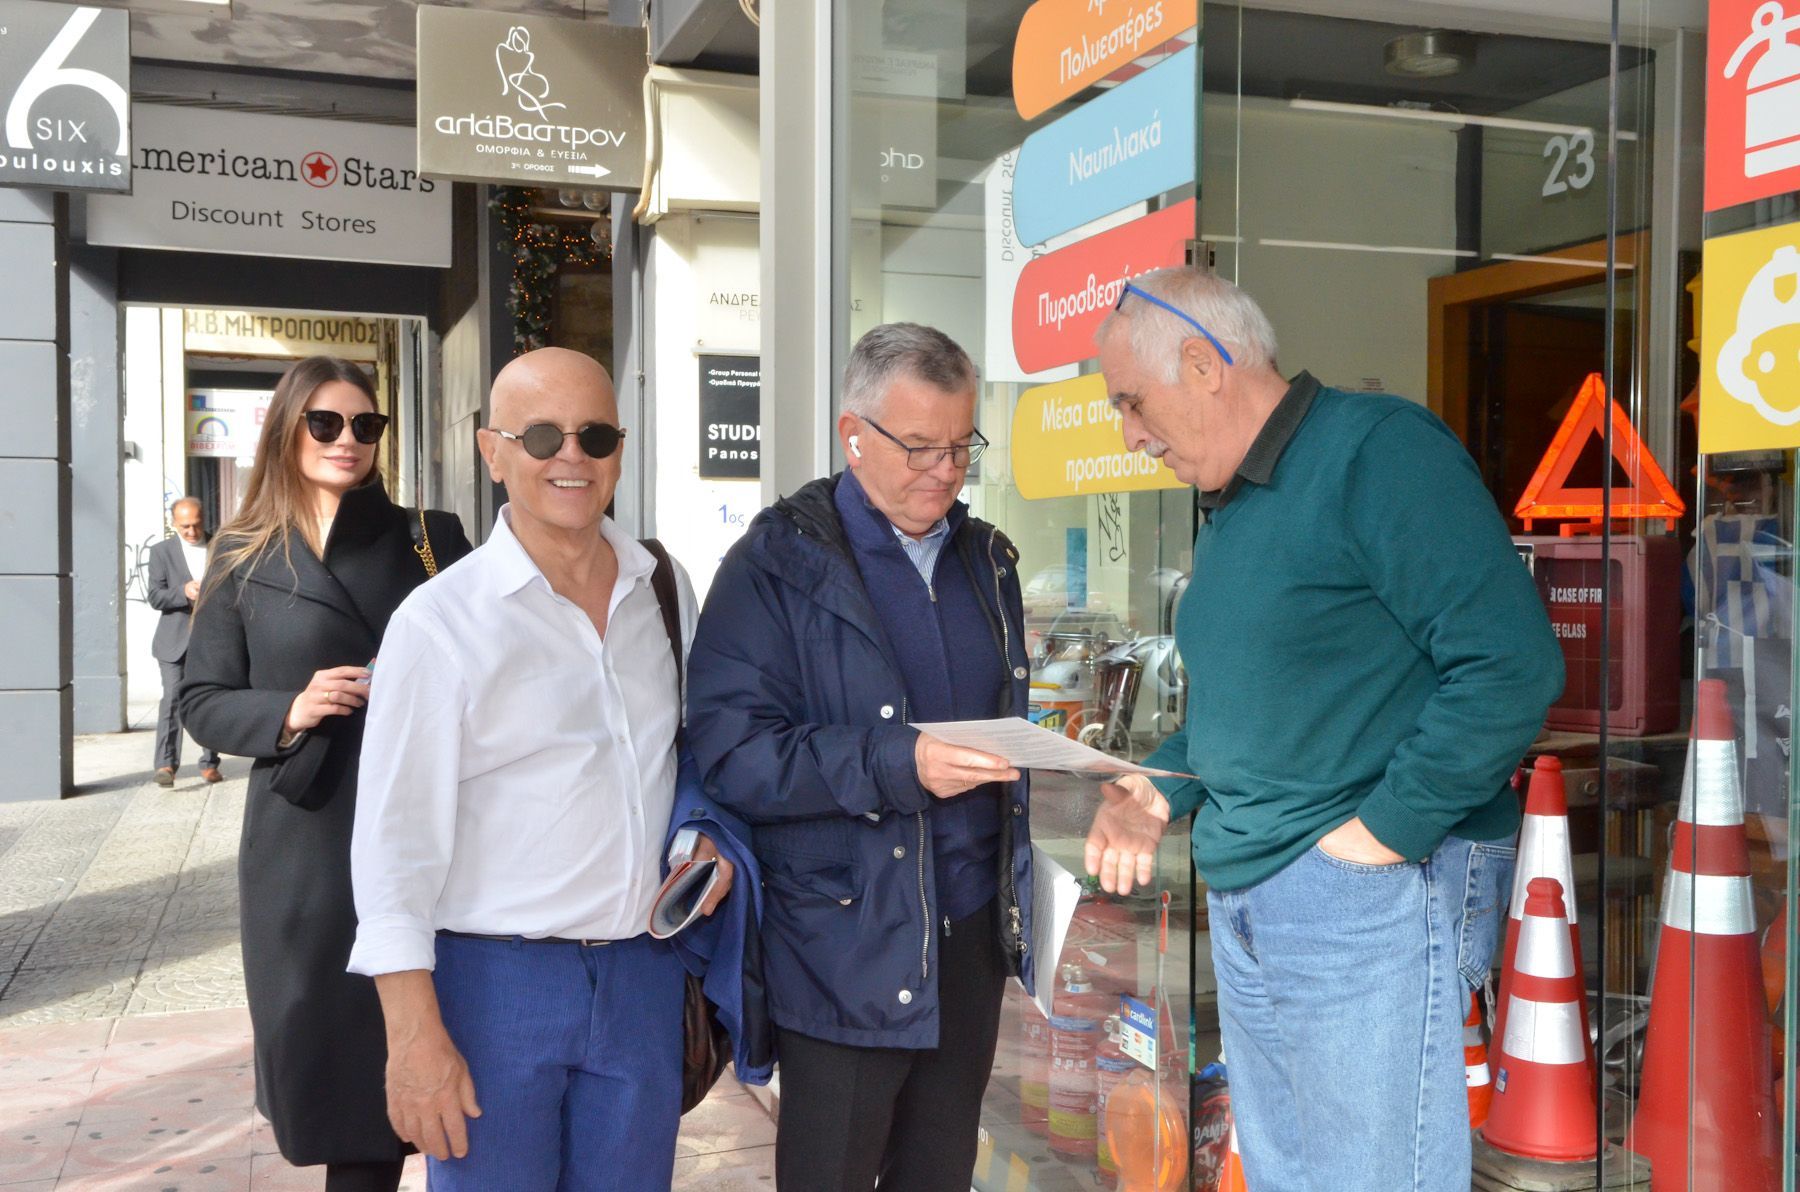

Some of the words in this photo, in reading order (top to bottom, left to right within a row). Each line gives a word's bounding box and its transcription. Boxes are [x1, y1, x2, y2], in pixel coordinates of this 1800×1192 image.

[1059, 2, 1163, 84] Πολυεστέρες
[36, 117, 87, 143] SIX
[475, 143, 531, 157] ΟΜΟΡΦΙΑ
[536, 149, 545, 158] &
[550, 149, 588, 161] ΕΥΕΞΙΑ
[1069, 109, 1161, 186] Ναυτιλιακά
[1542, 131, 1595, 197] 23
[132, 147, 298, 181] merican
[344, 158, 435, 193] Stars
[172, 200, 283, 228] Discount
[301, 211, 377, 234] Stores
[1038, 265, 1160, 331] Πυροσβεστ
[1041, 397, 1082, 432] Μέσα
[708, 447, 758, 460] Panos
[718, 504, 744, 527] 1ος
[1557, 587, 1577, 603] CASE
[1578, 587, 1589, 603] OF
[1589, 587, 1603, 603] FIR
[1562, 623, 1587, 638] GLASS
